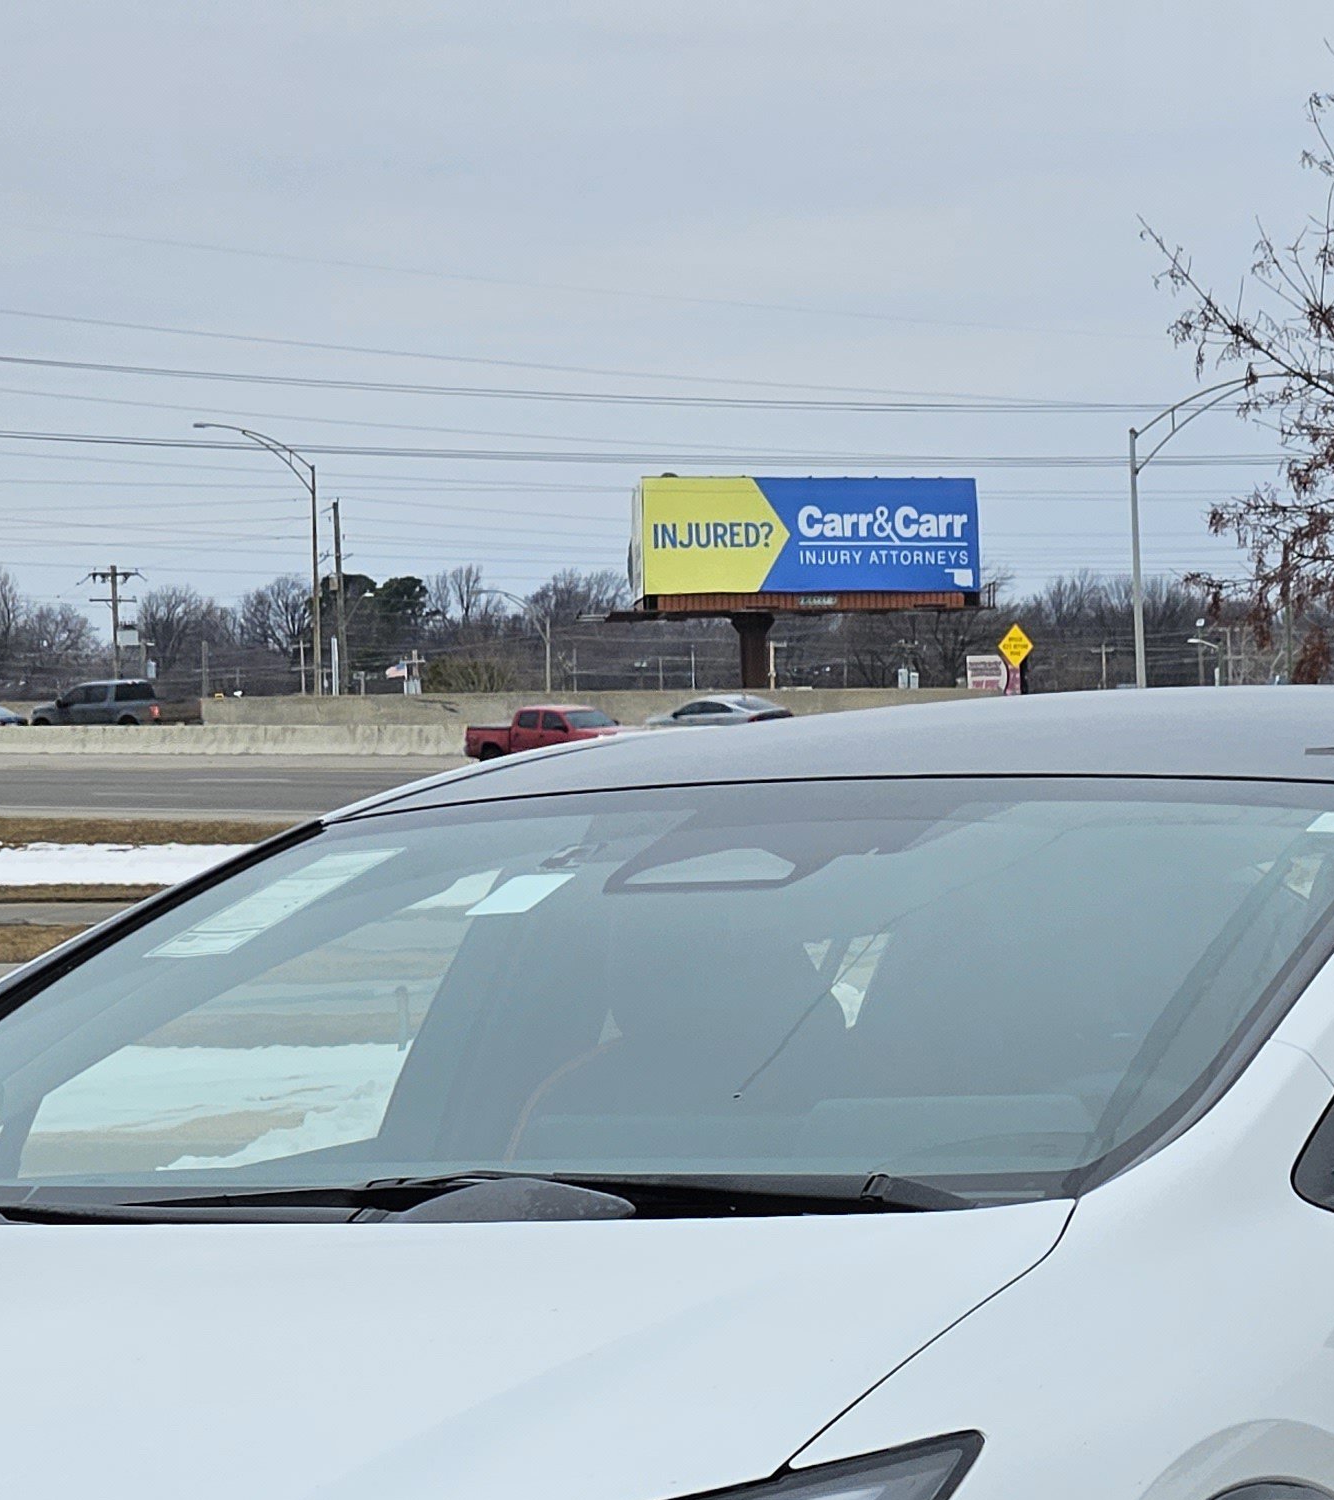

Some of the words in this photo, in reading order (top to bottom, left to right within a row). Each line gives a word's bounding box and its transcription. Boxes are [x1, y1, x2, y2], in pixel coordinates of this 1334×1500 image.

[652, 521, 774, 550] INJURED?
[797, 504, 968, 544] Carr&Carr
[799, 550, 861, 566] INJURY
[868, 550, 969, 566] ATTORNEYS
